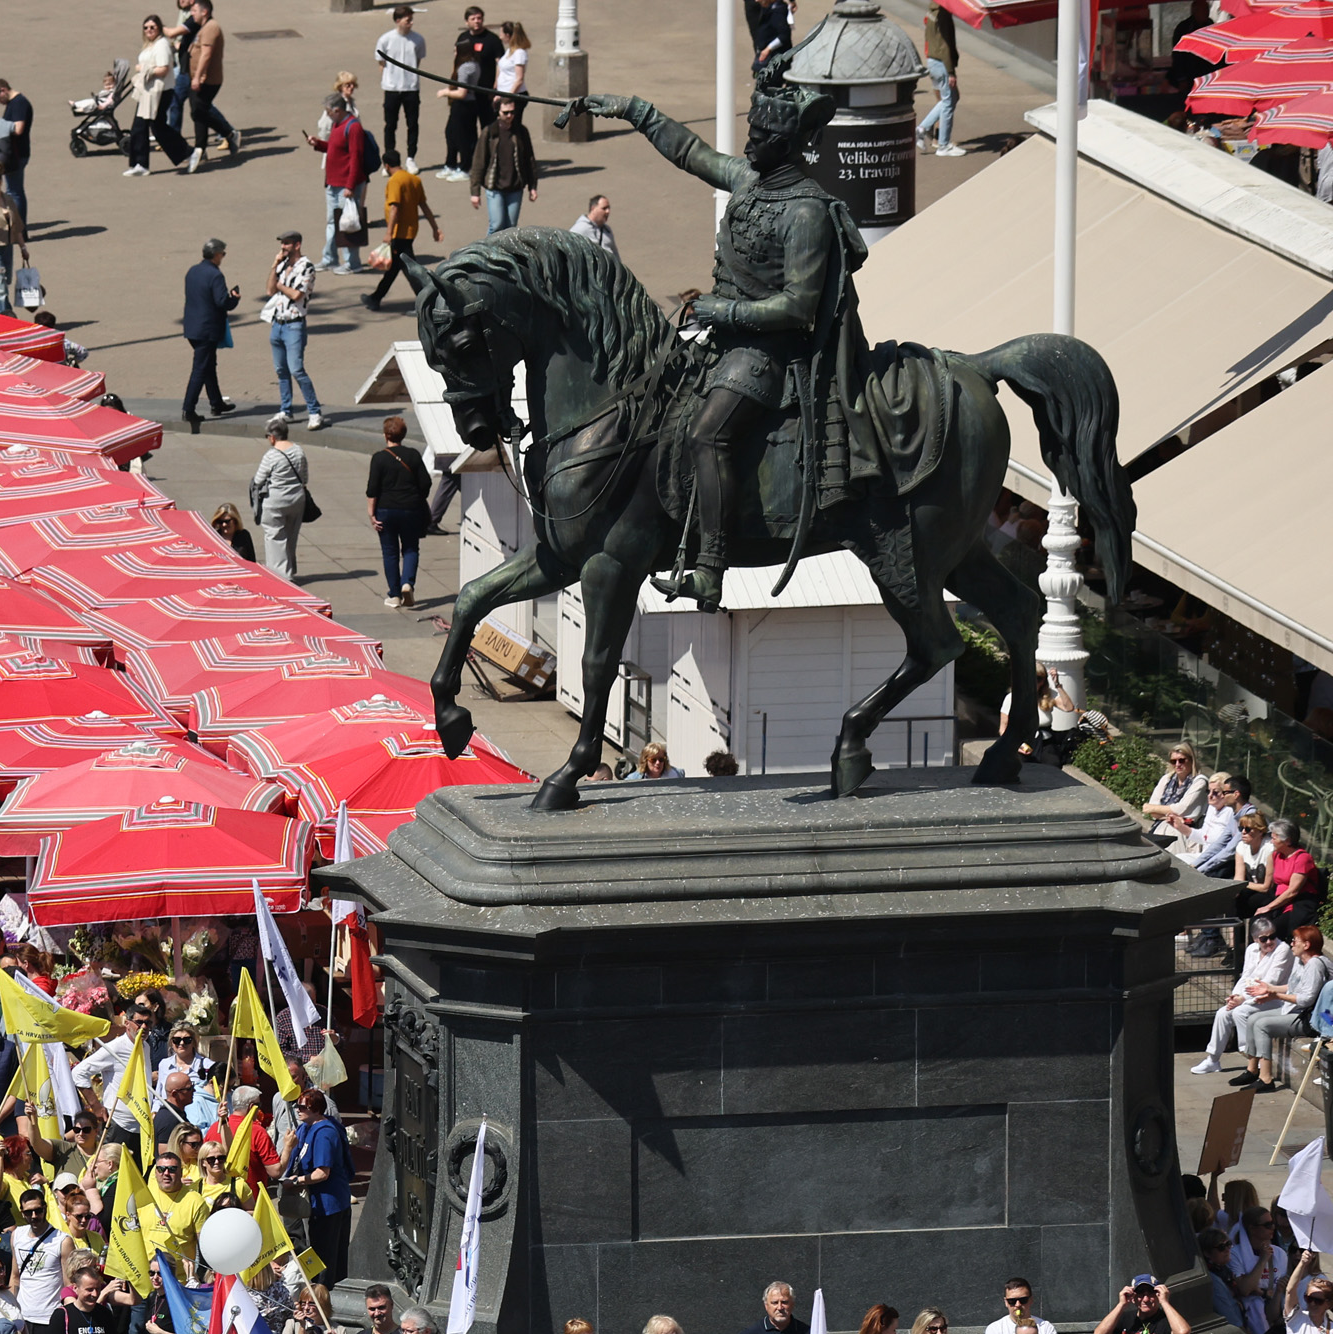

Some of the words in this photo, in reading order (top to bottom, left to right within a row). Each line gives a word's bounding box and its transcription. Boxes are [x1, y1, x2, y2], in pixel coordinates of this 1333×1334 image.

[838, 152, 879, 164] Veliko
[839, 168, 856, 180] 23.
[859, 164, 901, 180] travnja
